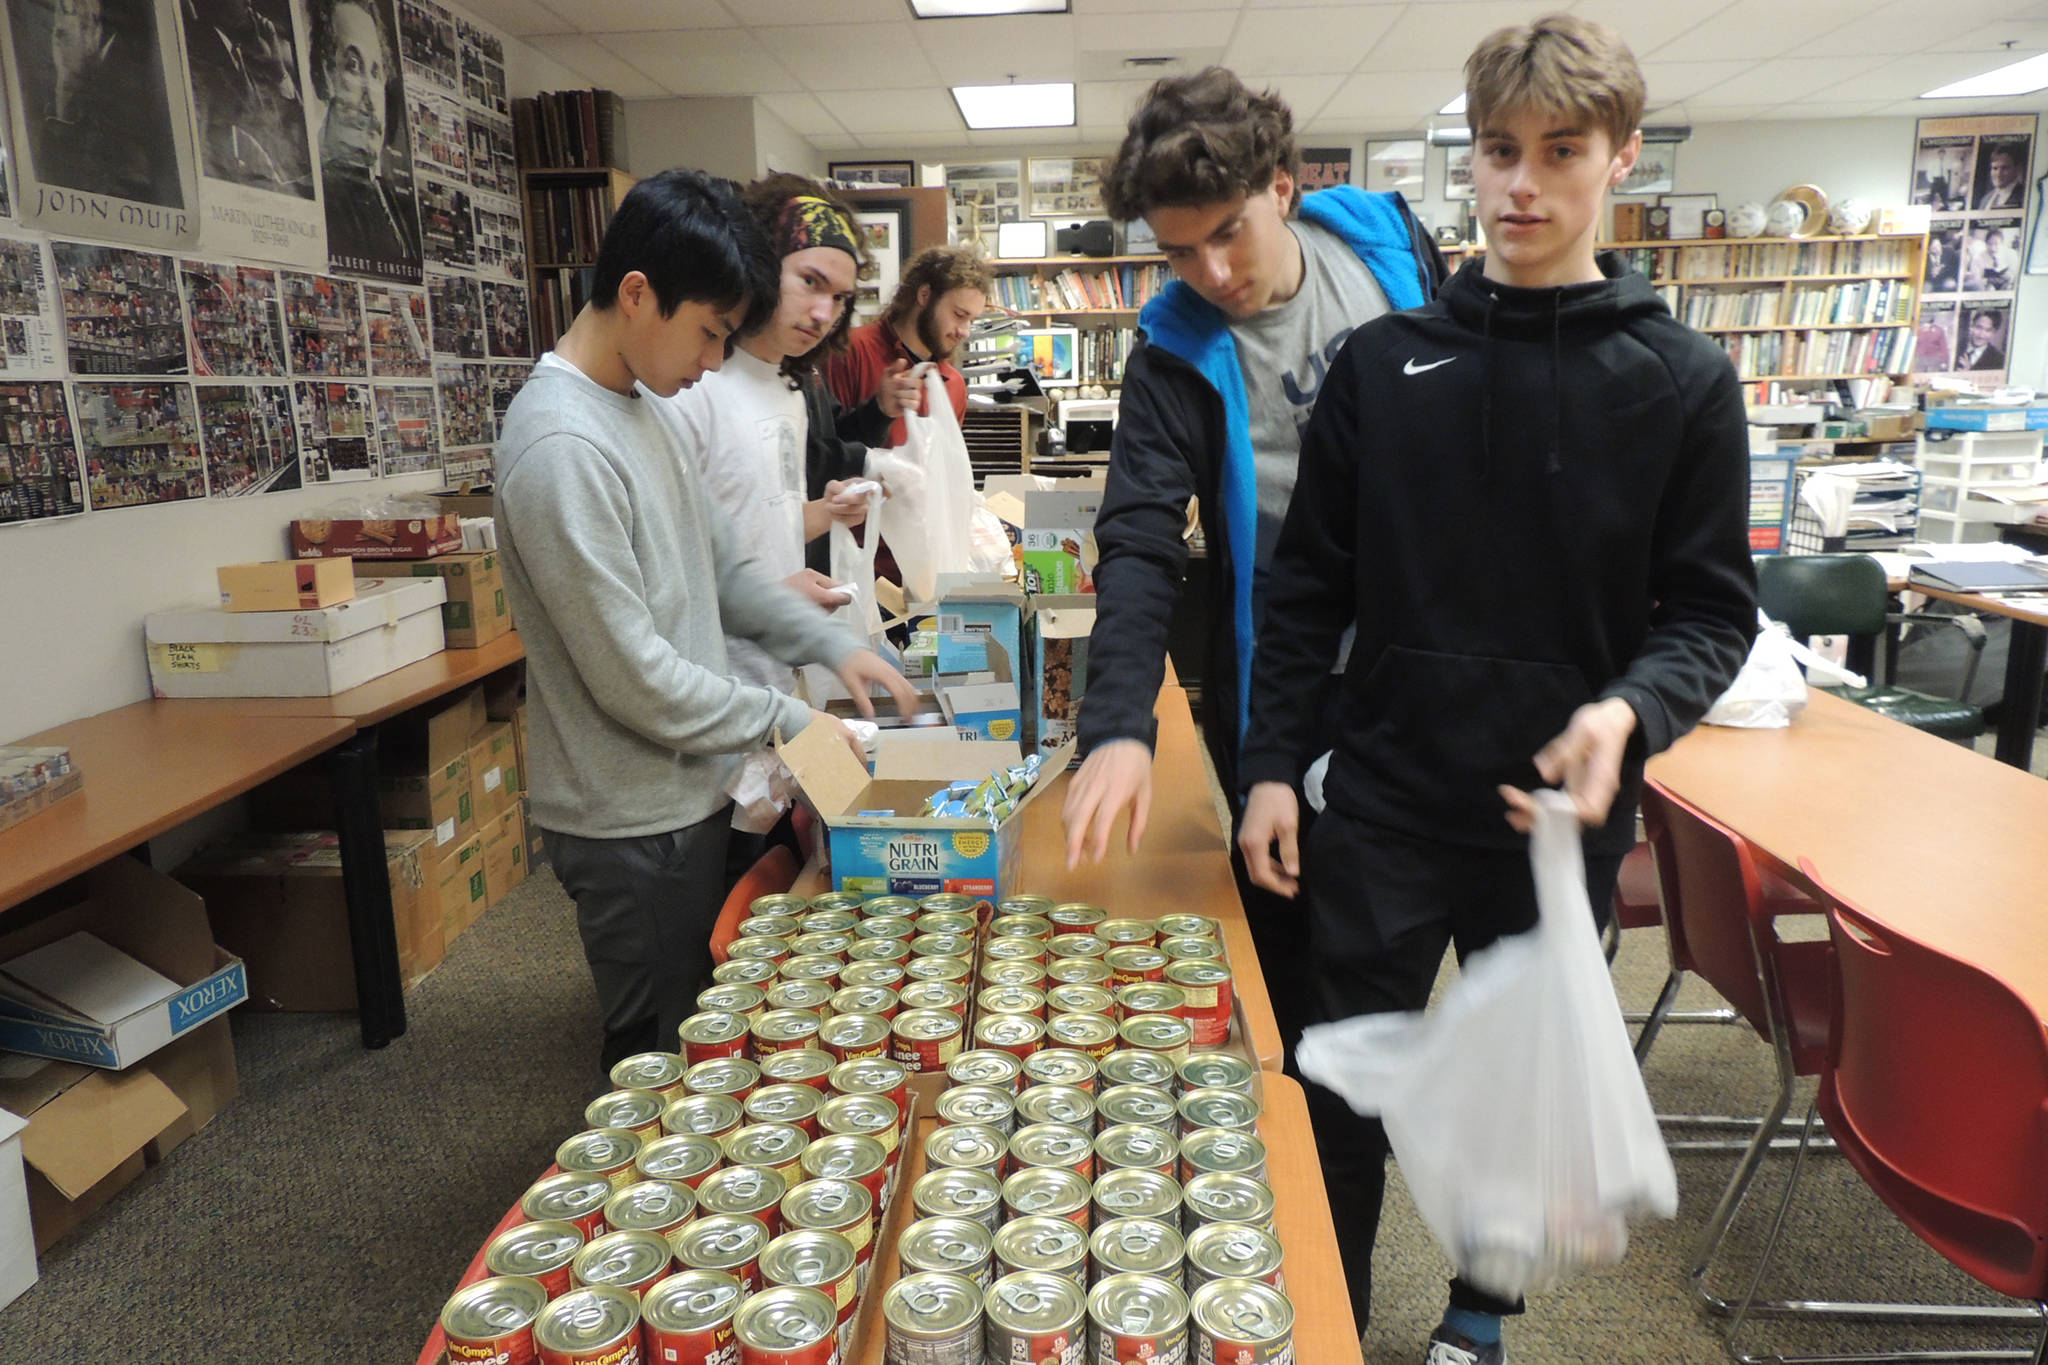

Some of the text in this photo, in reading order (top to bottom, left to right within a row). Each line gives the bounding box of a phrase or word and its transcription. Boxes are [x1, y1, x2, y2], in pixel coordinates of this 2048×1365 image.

[330, 254, 423, 278] ALBERT EINSTEIN
[367, 546, 391, 554] BROWN
[889, 843, 938, 858] NUTRI
[889, 857, 939, 871] GRAIN
[178, 970, 239, 1019] XEROX
[36, 1028, 104, 1057] XEROX
[461, 1345, 494, 1359] Camp's
